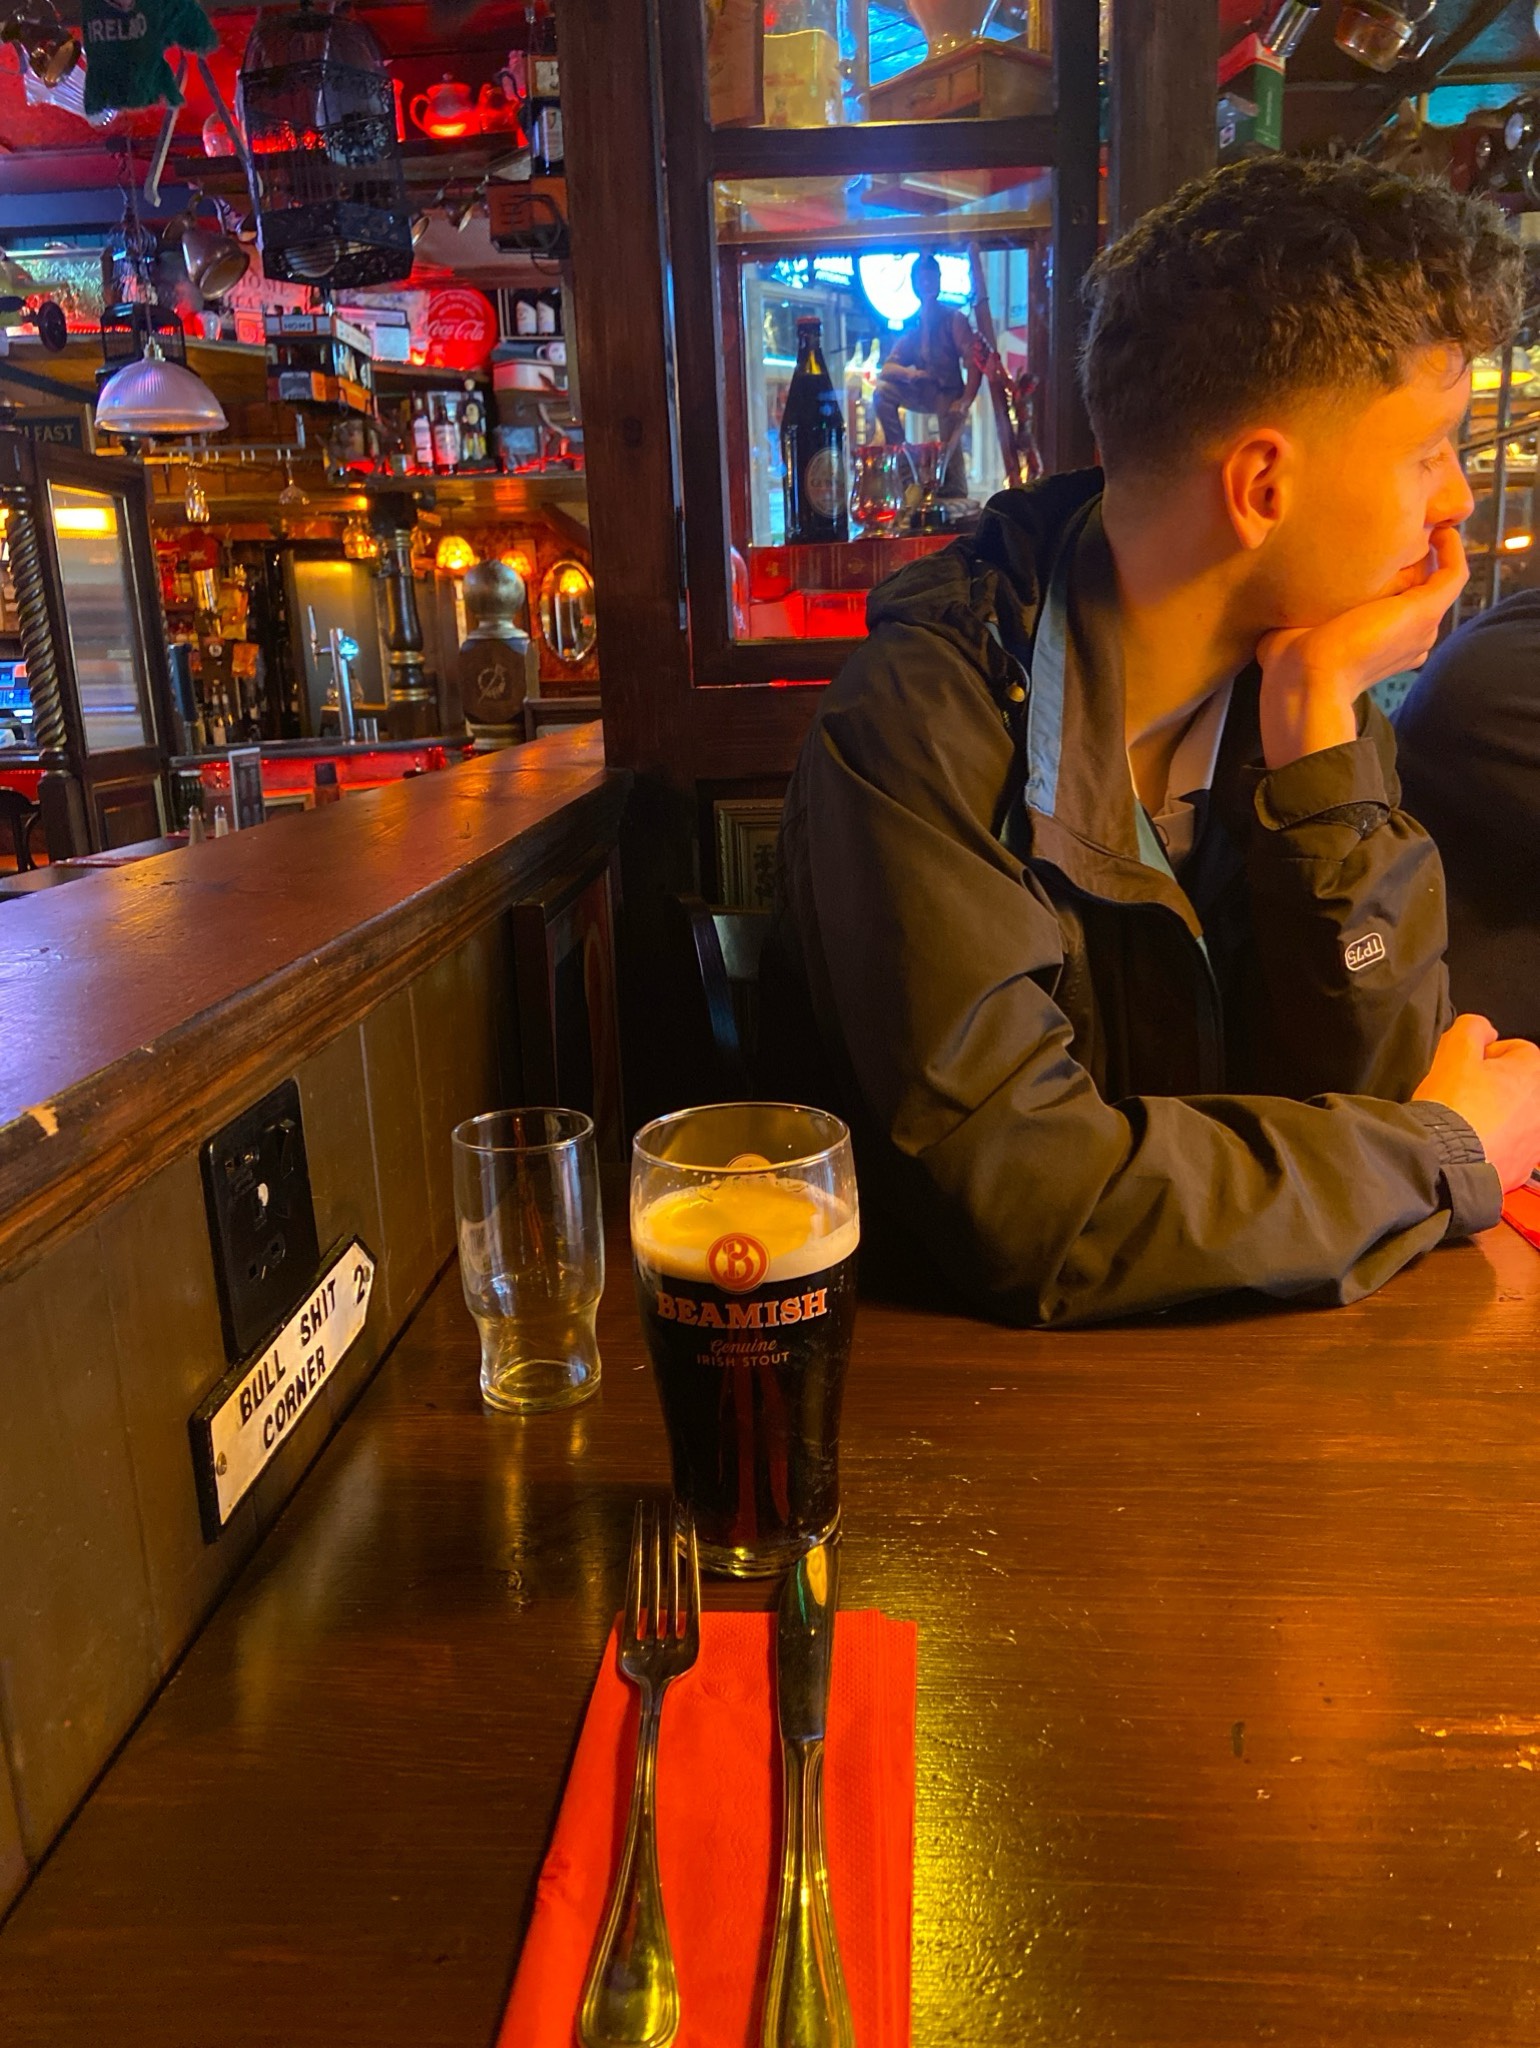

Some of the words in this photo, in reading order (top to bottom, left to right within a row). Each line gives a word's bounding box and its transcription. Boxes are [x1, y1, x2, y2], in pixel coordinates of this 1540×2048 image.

[1347, 938, 1383, 966] TP75
[655, 1288, 828, 1329] BEAMISH
[239, 1350, 286, 1427] BULL
[300, 1279, 337, 1347] SHIT
[697, 1354, 736, 1367] IRISH
[742, 1351, 790, 1368] STOUT
[710, 1338, 778, 1356] Genuine
[262, 1345, 327, 1450] CORNER
